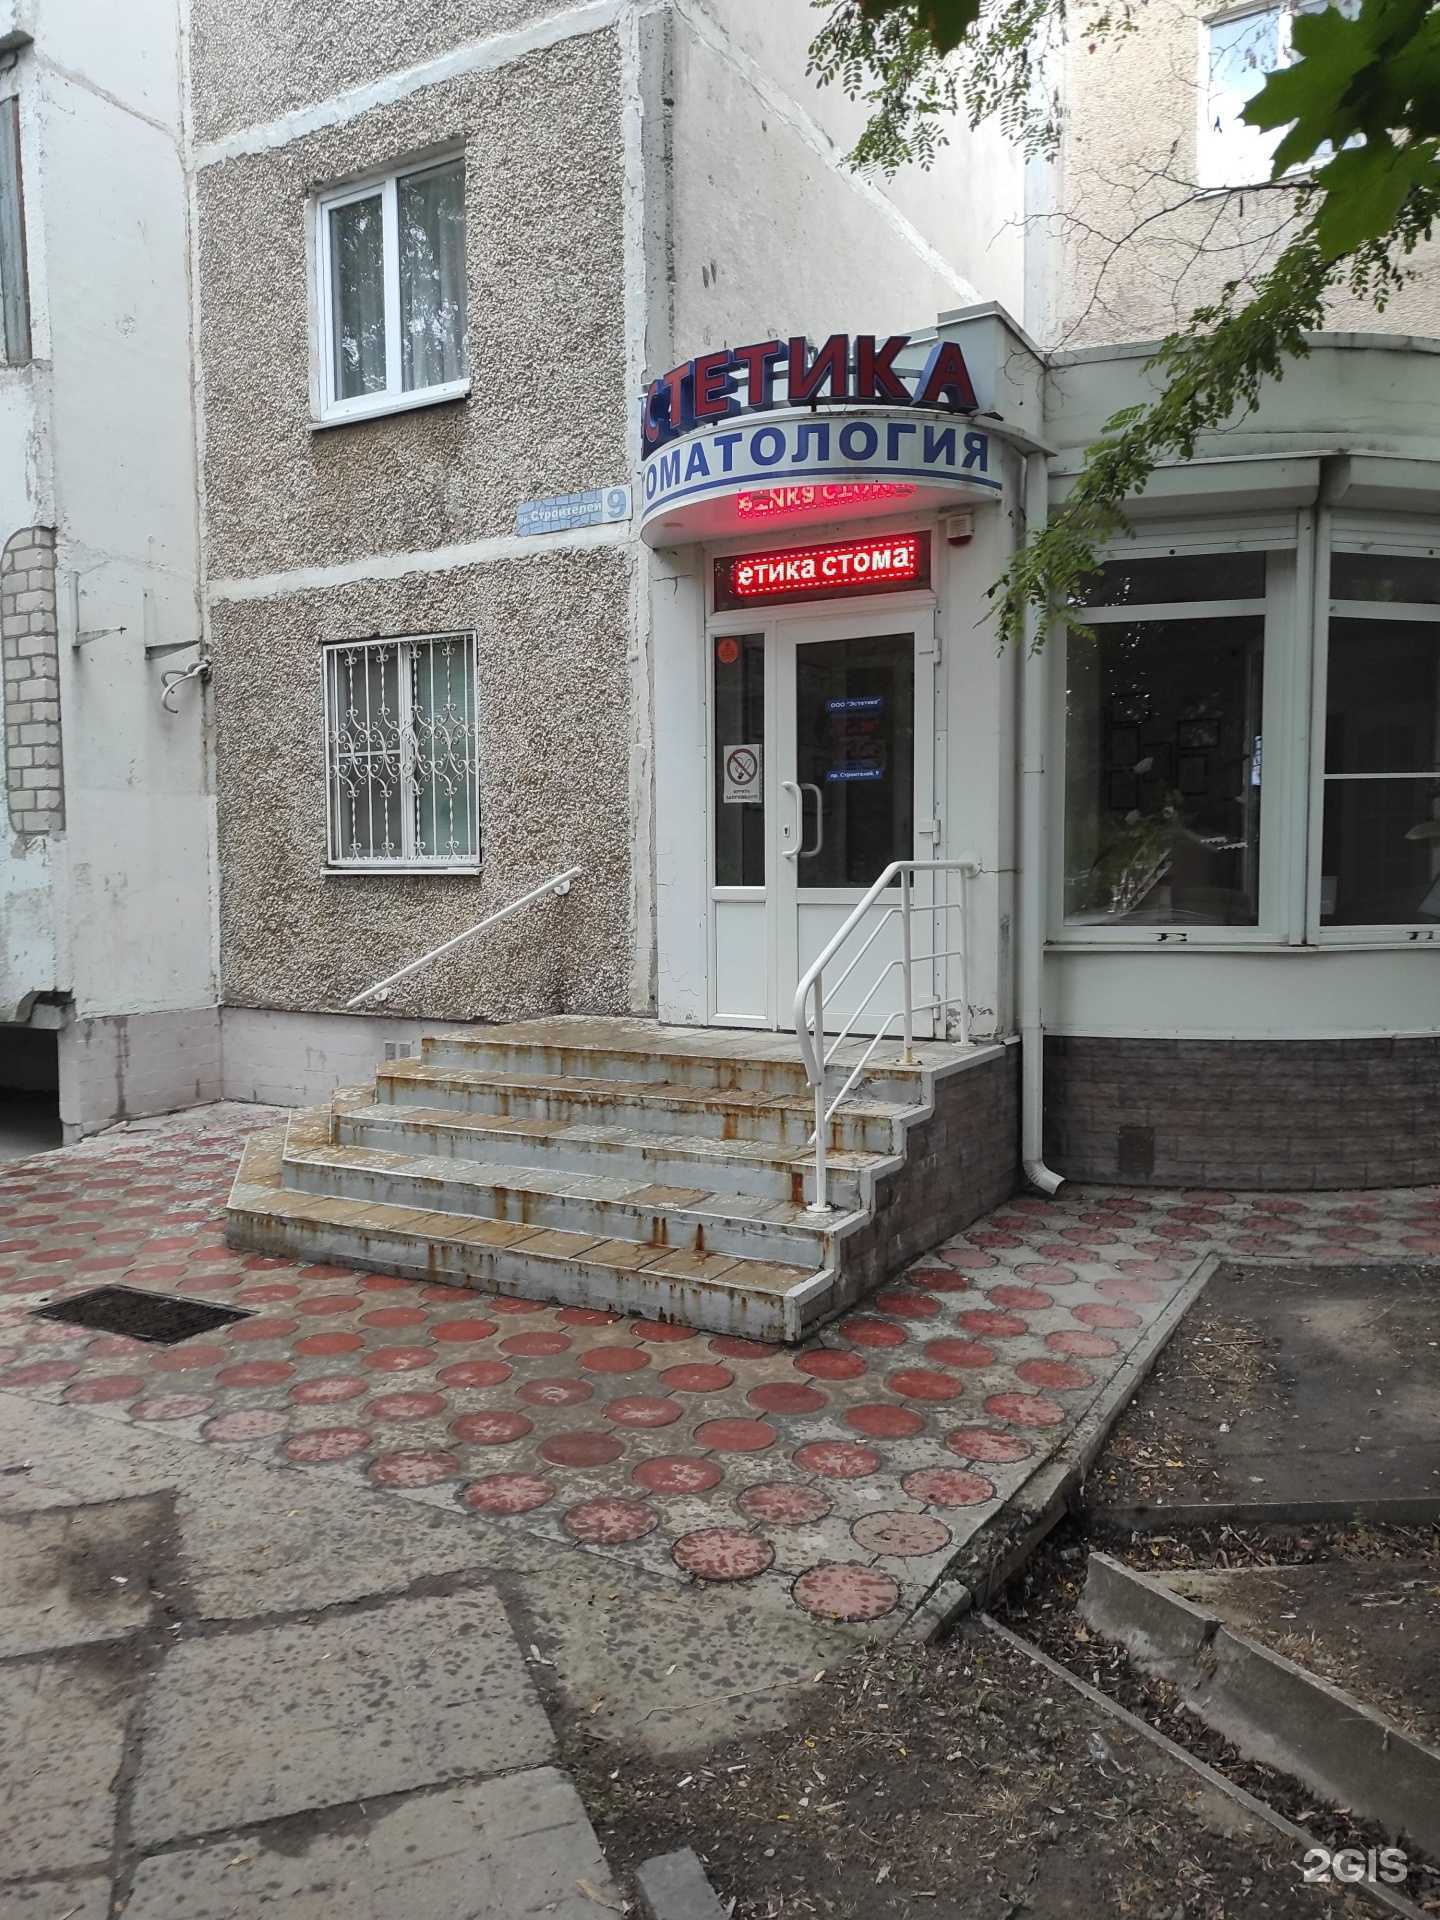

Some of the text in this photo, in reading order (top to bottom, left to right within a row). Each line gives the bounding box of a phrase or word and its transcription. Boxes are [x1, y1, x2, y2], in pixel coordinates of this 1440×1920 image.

[643, 333, 978, 443] СТЕТИКА
[643, 421, 989, 500] ОМАТОЛОГИЯ
[607, 488, 627, 518] 9
